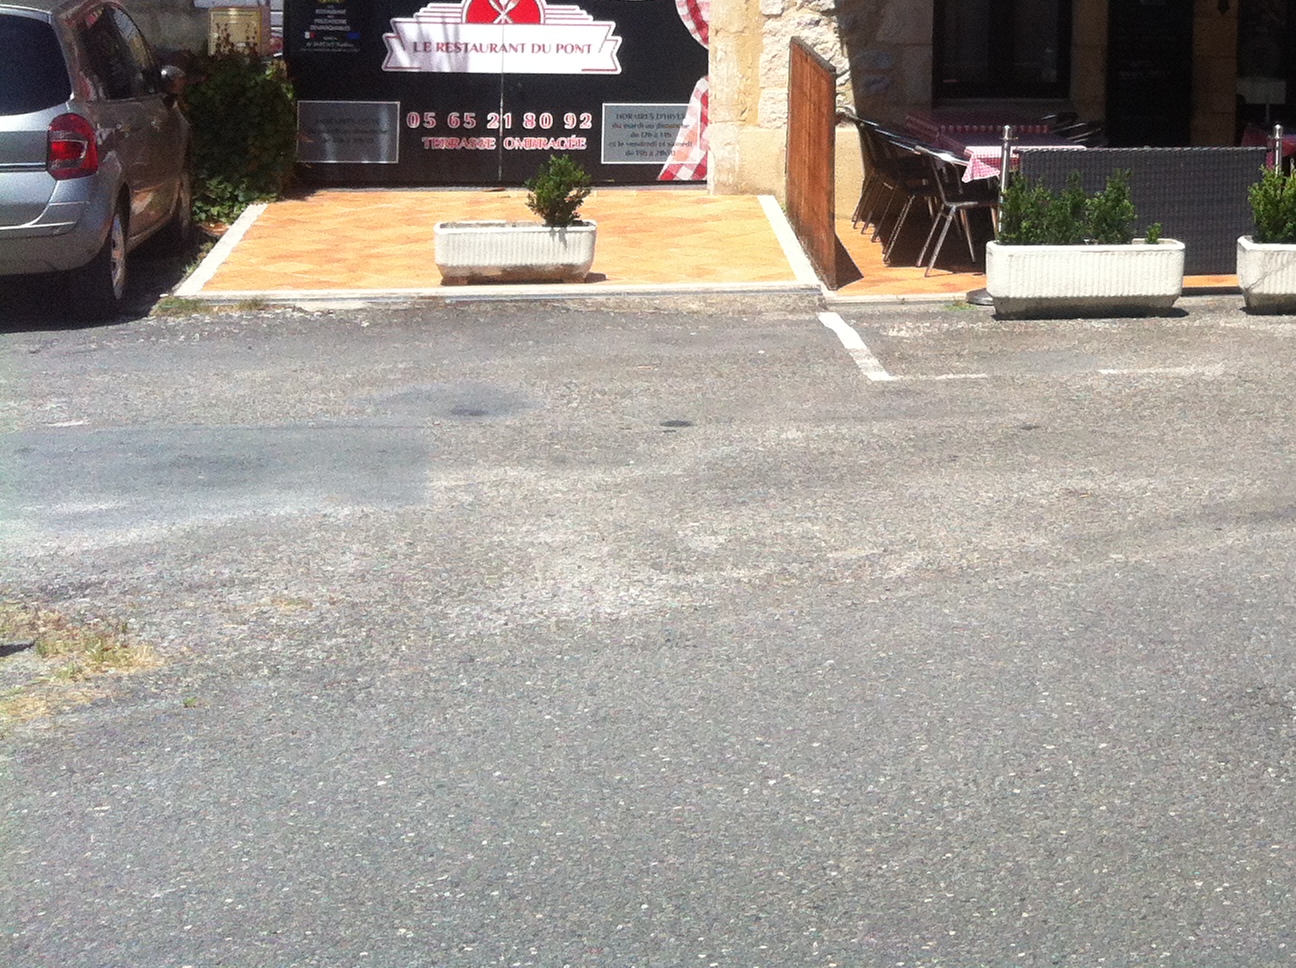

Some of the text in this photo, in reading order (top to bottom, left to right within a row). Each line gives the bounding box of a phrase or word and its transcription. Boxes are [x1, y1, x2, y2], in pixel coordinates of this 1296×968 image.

[412, 41, 592, 55] LE RESTAURANT DU PONT
[406, 111, 593, 129] 05 65 21 80 92
[421, 134, 588, 151] TERRASSE OMBRAGÉE
